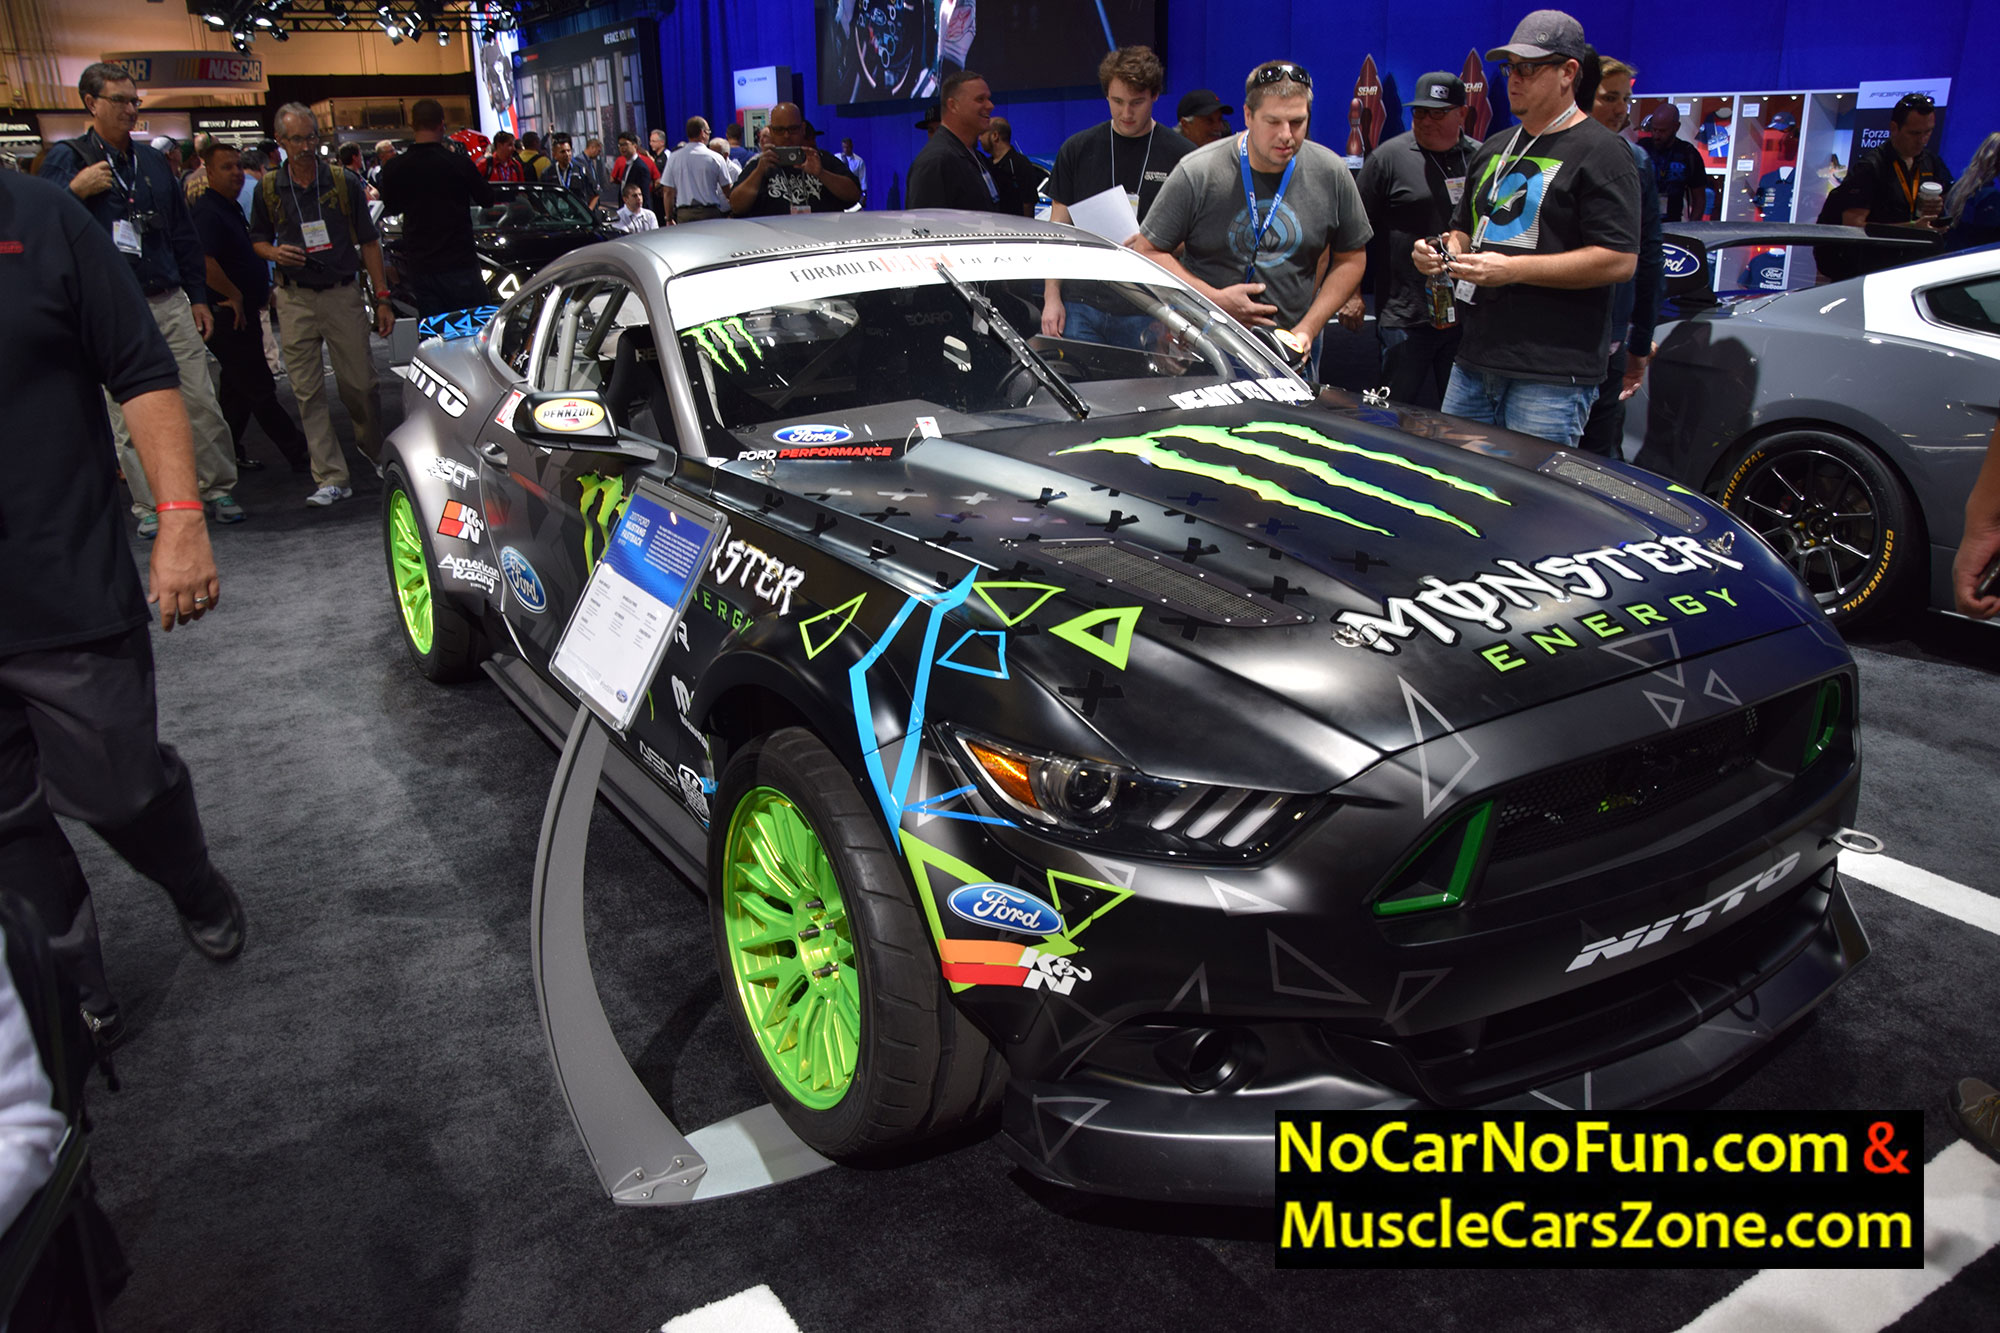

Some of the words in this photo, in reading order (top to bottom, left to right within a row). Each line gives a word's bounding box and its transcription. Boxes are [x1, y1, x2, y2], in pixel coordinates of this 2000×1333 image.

[113, 59, 147, 81] CAR
[208, 59, 262, 82] NASCAR
[1357, 86, 1379, 96] SEMA
[1862, 128, 1890, 138] Forza
[790, 260, 883, 283] FORMULA
[904, 311, 953, 326] ECARO
[543, 407, 595, 419] PENNZOIL
[737, 450, 777, 461] FORD
[779, 446, 893, 459] PERFORMANCE
[1722, 450, 1766, 510] NTINENTAL
[438, 553, 500, 581] American
[709, 525, 805, 616] STER
[1843, 529, 1894, 612] CONTINENTAL
[452, 566, 496, 594] Racing
[693, 588, 755, 636] ERGY
[1481, 588, 1739, 672] ENERGY
[1565, 852, 1800, 973] NITTO
